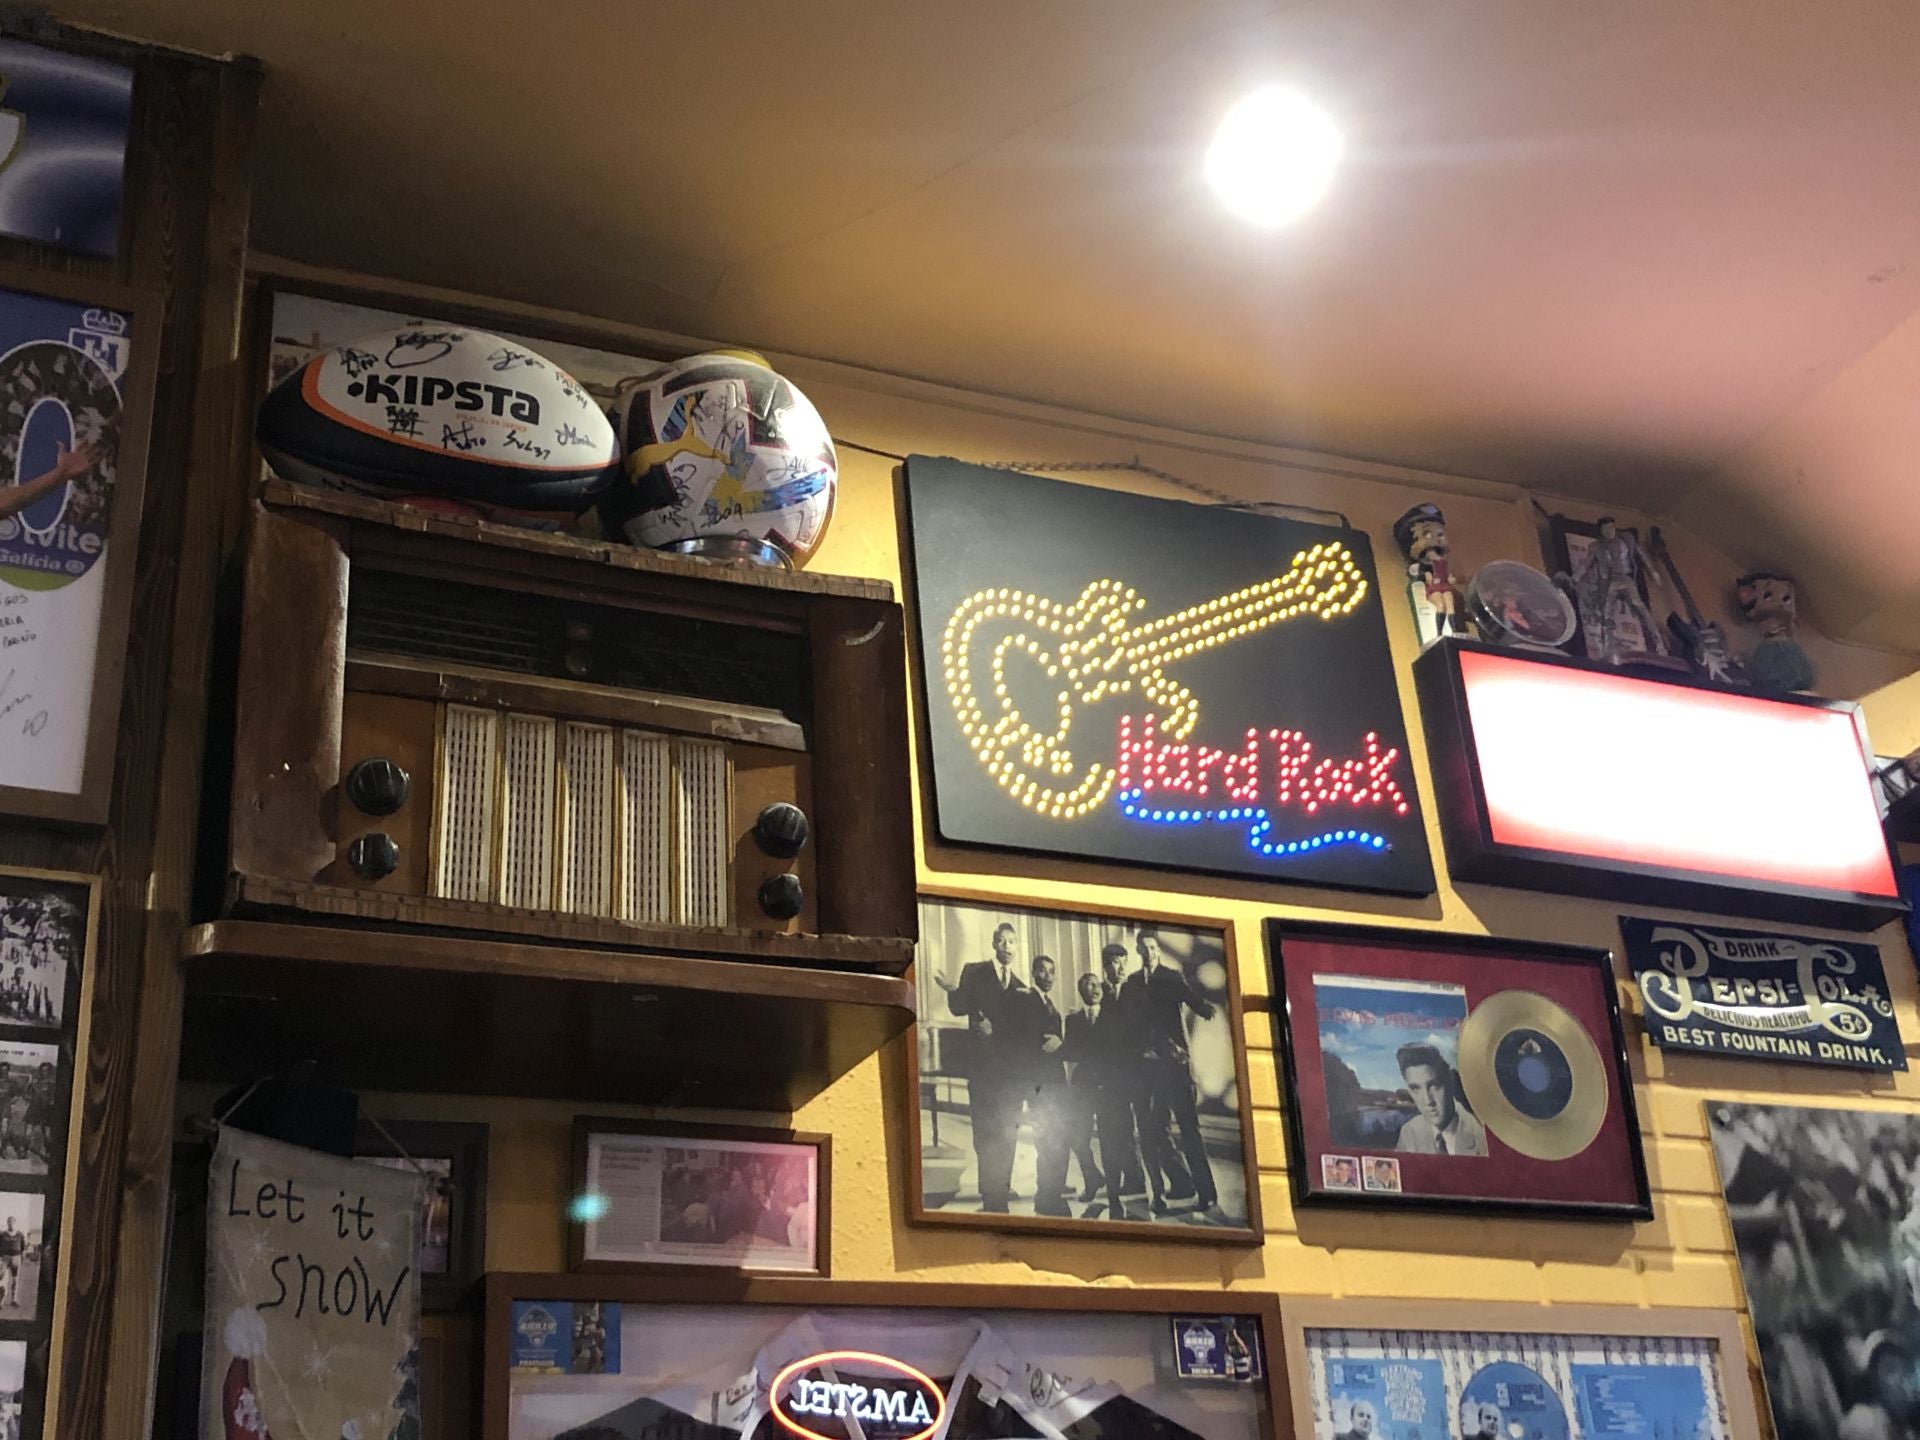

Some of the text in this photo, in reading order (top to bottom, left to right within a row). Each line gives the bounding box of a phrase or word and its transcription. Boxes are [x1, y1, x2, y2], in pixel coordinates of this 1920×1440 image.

[1119, 713, 1410, 814] Hard Rock
[1726, 938, 1781, 958] DRINK
[1663, 1025, 1716, 1047] BEST
[1721, 1031, 1812, 1057] FOUNTAIN
[228, 1159, 374, 1241] Let it
